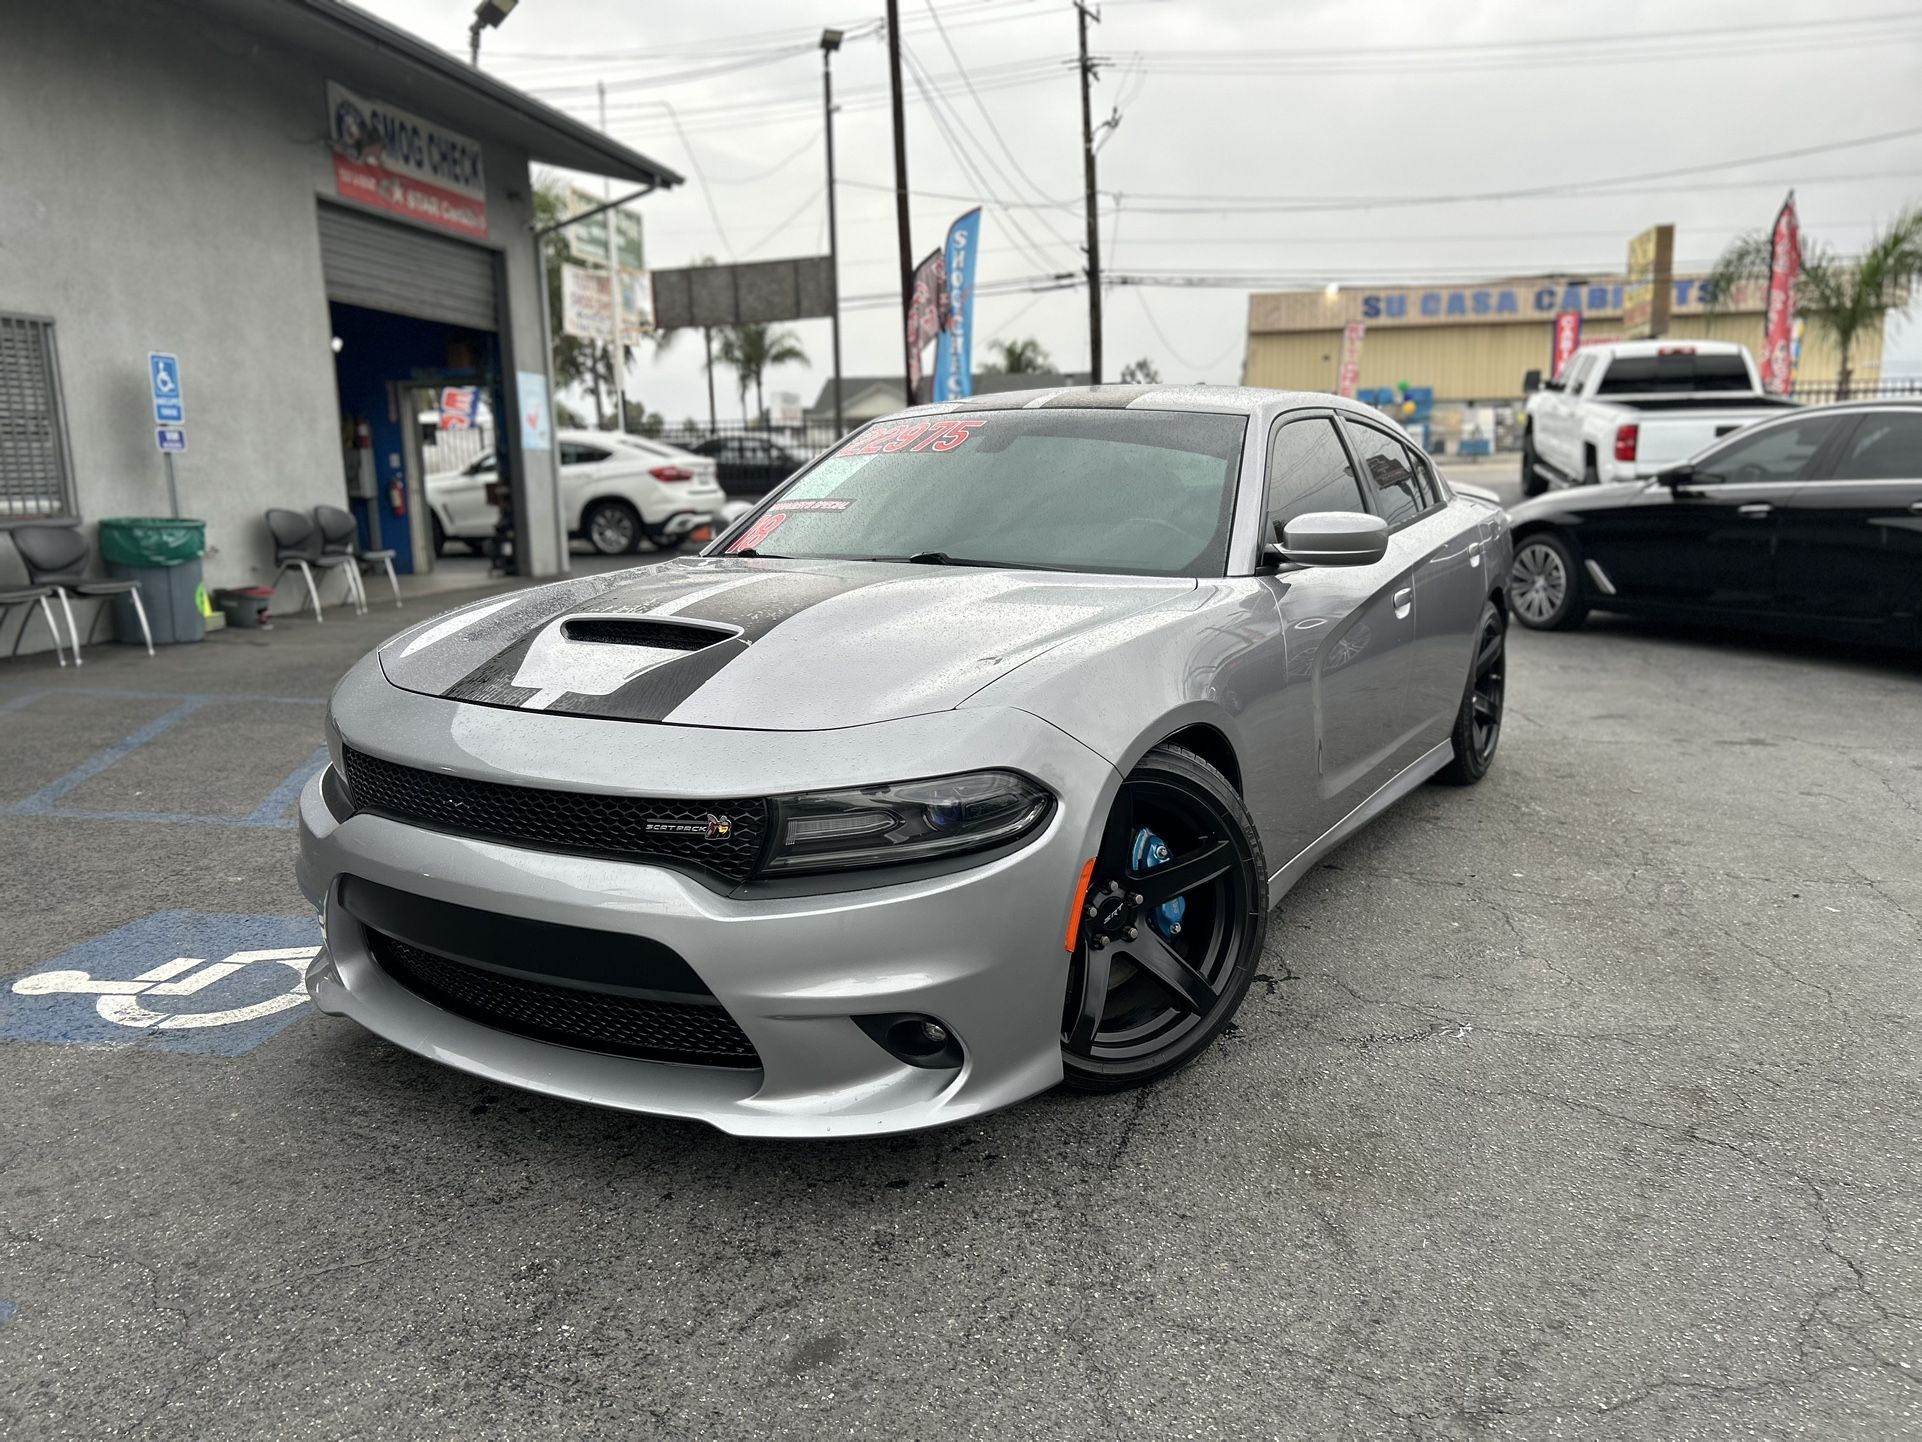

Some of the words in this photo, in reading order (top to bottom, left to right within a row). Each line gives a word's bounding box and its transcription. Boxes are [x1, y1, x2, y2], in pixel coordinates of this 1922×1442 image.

[370, 110, 424, 168] SMOG
[428, 132, 480, 187] CHECK
[1363, 295, 1407, 318] SU
[1420, 290, 1518, 317] CASA
[1535, 280, 1714, 312] CABITS
[836, 420, 988, 458] 22975
[1103, 903, 1124, 924] SRT
